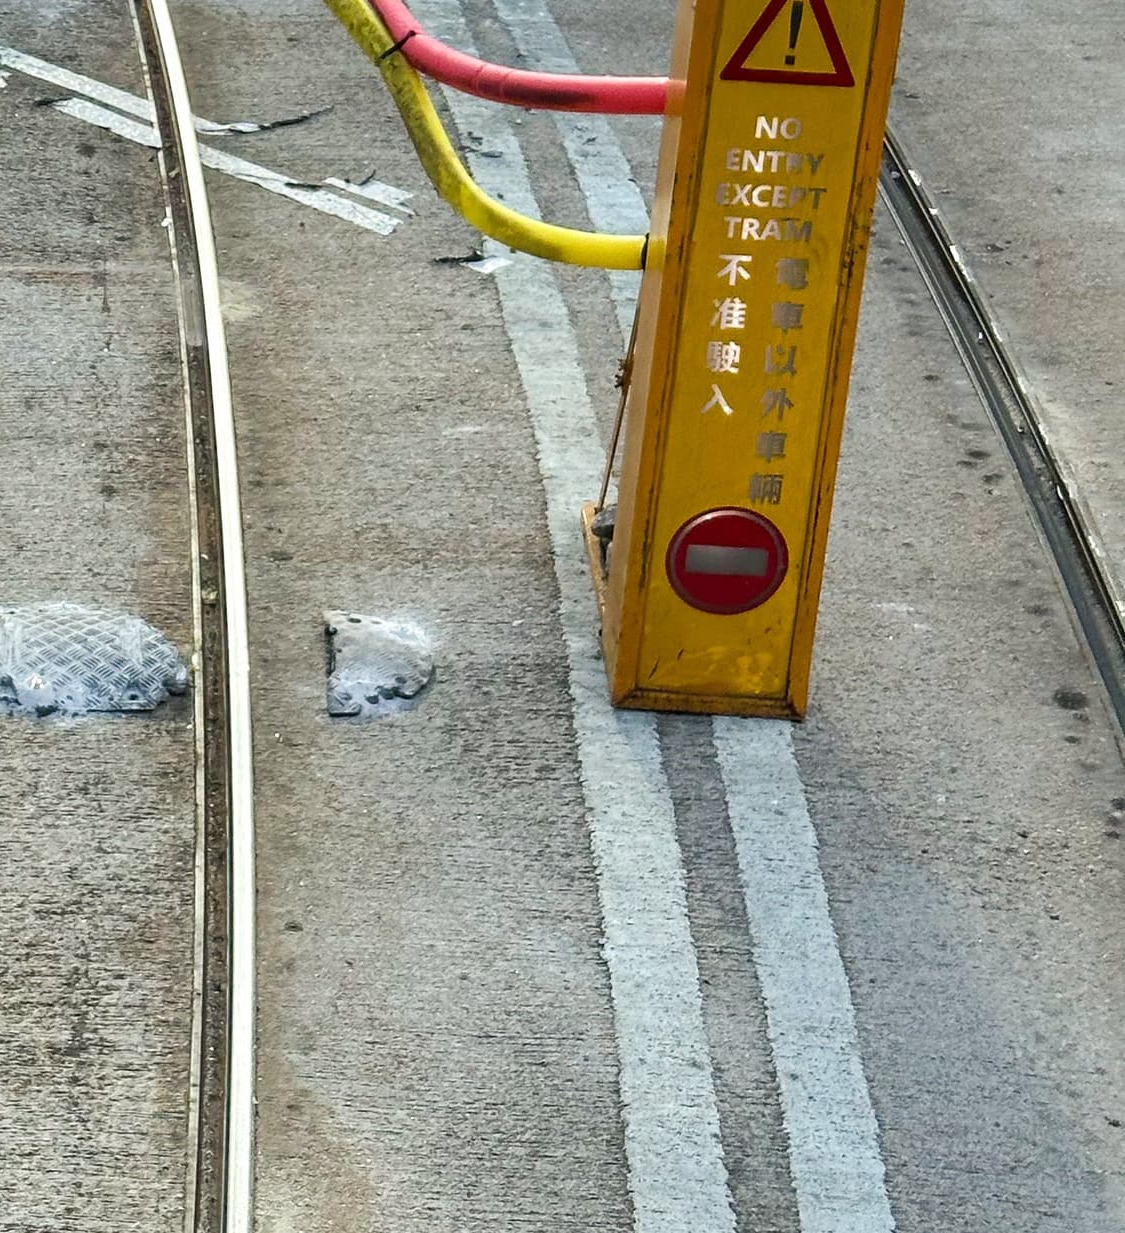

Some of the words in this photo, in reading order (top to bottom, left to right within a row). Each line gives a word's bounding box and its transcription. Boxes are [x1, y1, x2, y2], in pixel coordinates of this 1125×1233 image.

[755, 115, 802, 140] NO
[726, 148, 824, 175] ENTRY
[715, 183, 827, 209] EXCEPT
[723, 216, 813, 243] TRAM
[700, 254, 752, 416] 不准駛入
